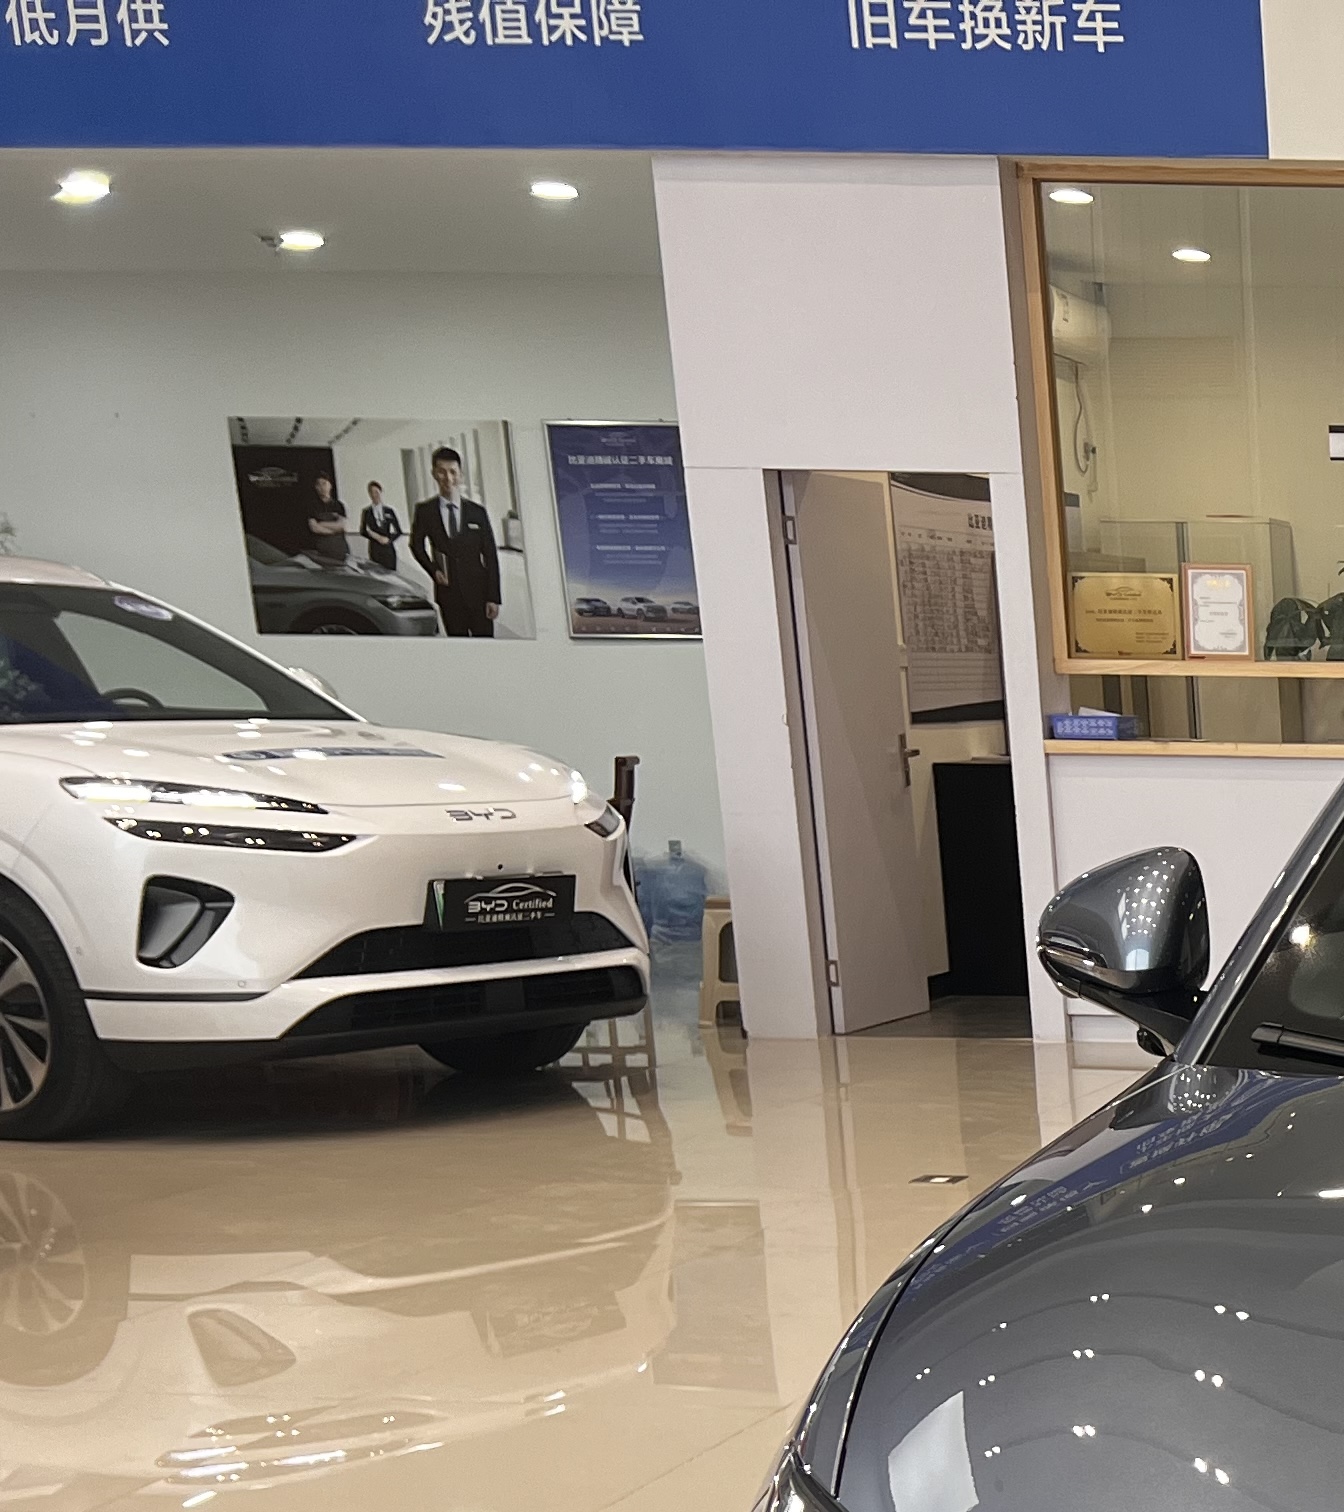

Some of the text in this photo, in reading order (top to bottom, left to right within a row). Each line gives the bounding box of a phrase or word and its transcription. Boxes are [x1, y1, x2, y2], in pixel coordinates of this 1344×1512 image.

[5, 0, 170, 47] 低月供
[424, 0, 645, 47] 残值保障
[846, 0, 1125, 53] 旧车换新车
[445, 806, 517, 822] BYD
[467, 898, 553, 913] BYD Certified
